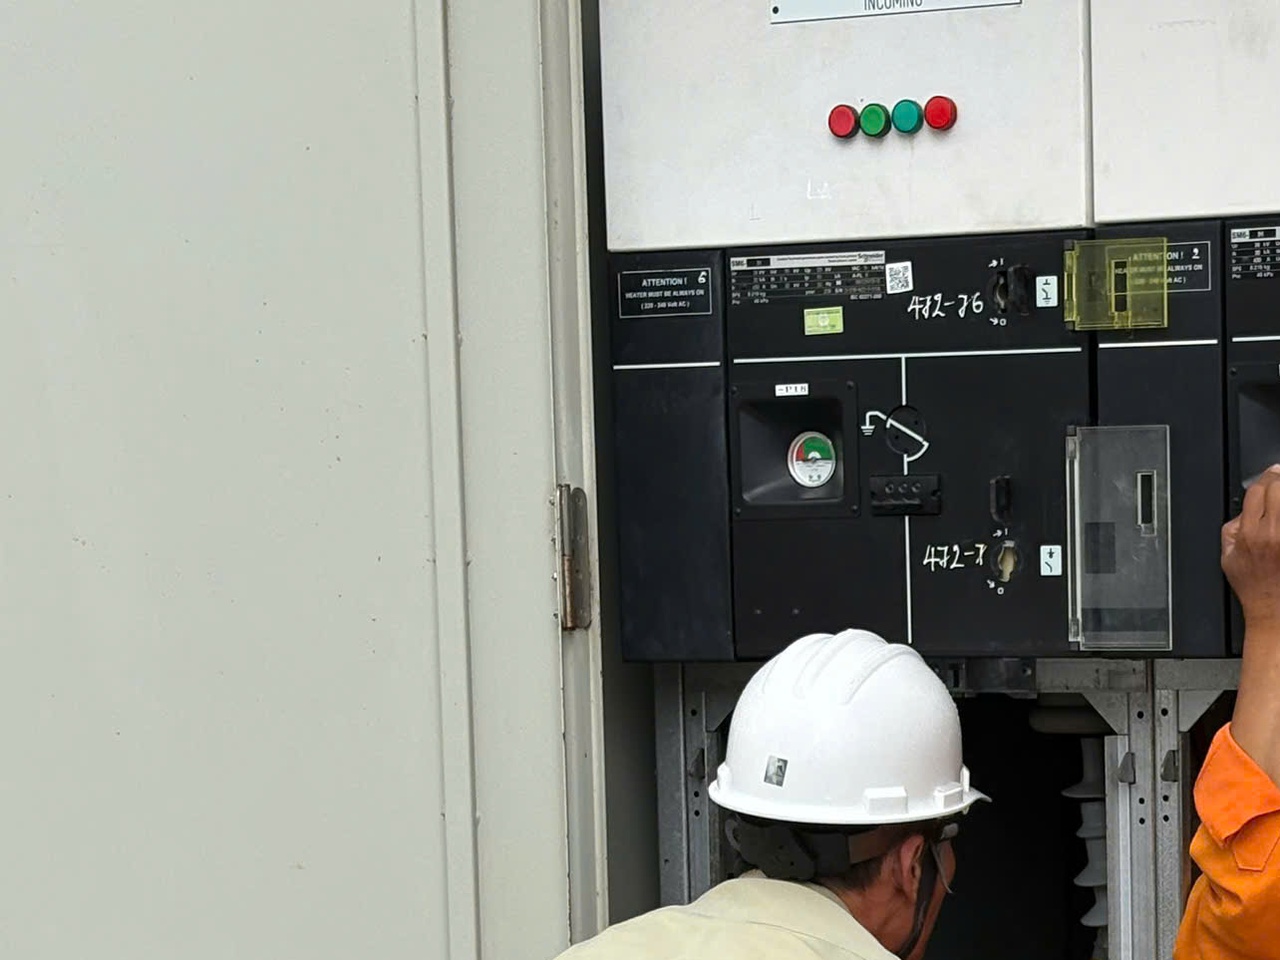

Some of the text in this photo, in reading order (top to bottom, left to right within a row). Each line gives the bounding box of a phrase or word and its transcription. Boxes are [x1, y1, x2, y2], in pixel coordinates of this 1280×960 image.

[1191, 248, 1200, 259] 2
[641, 278, 683, 287] ATTENTION
[698, 271, 707, 284] 6
[907, 292, 984, 320] 472-76
[922, 542, 987, 572] 472-7
